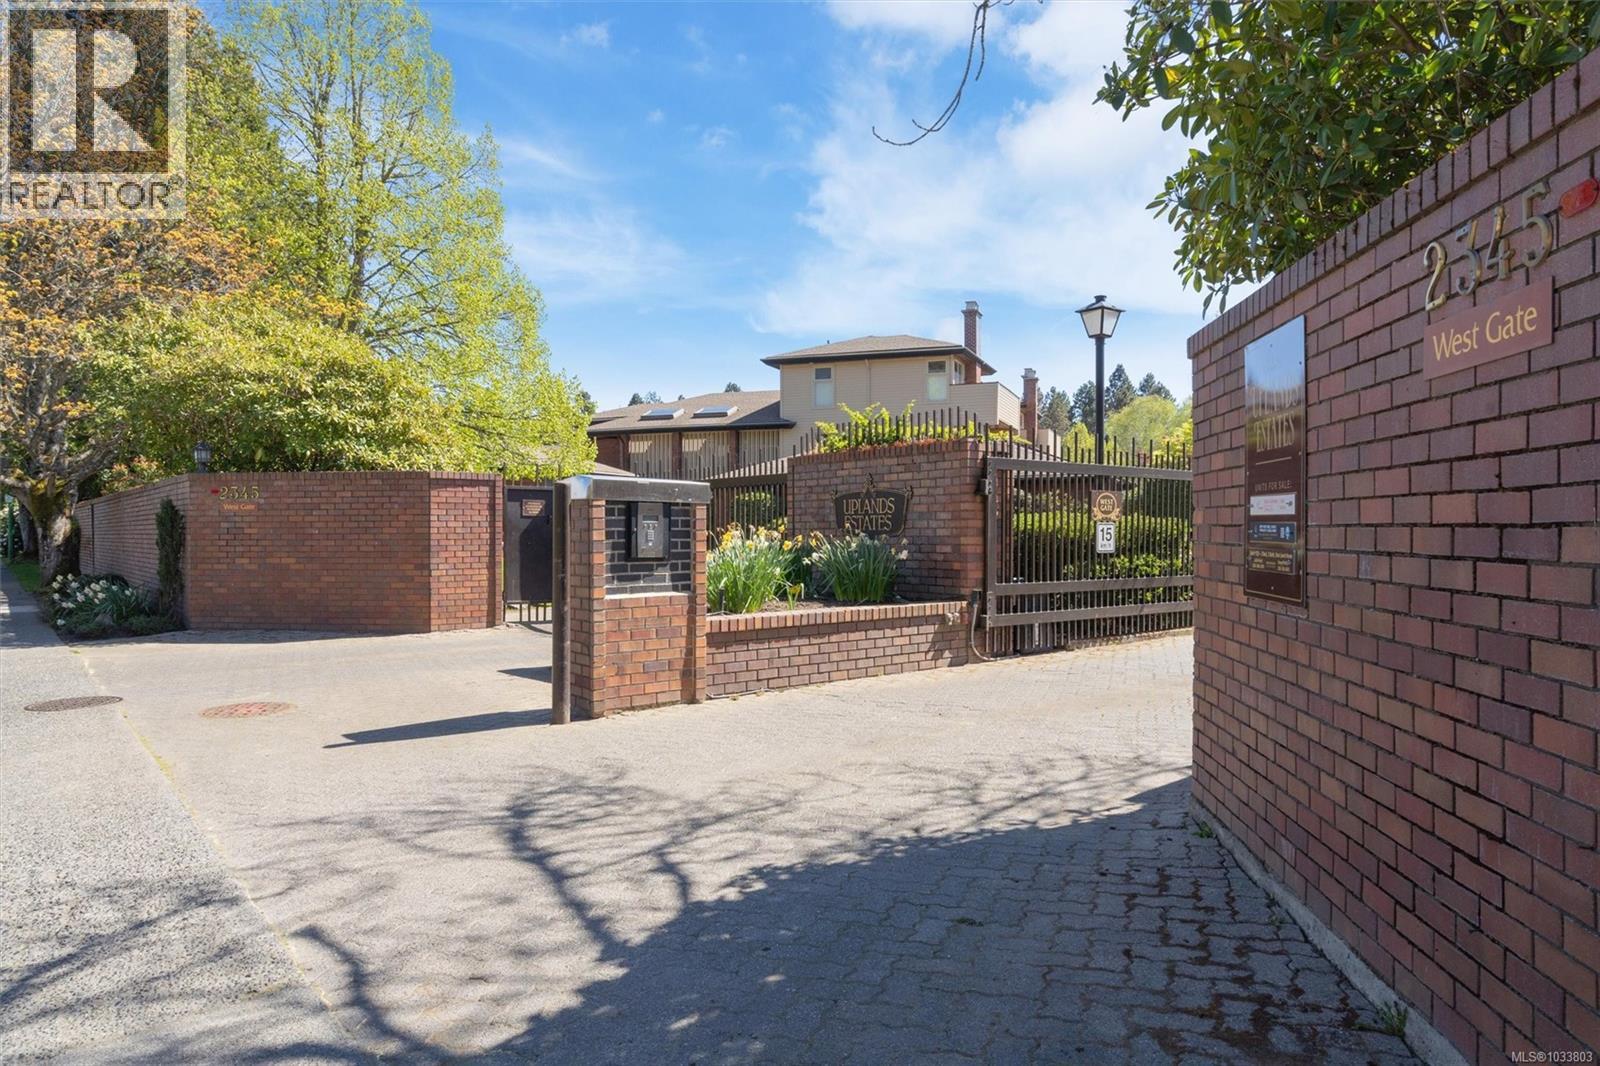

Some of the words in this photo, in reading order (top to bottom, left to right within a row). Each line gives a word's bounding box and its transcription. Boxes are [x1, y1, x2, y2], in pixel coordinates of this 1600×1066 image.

[1423, 182, 1553, 311] 2345
[1432, 322, 1480, 361] West
[1486, 304, 1538, 344] Gate
[220, 486, 259, 500] 2345
[1268, 481, 1278, 490] FOR
[843, 497, 895, 515] UPLANDS
[844, 514, 893, 531] ESTATES
[1100, 527, 1112, 541] 15
